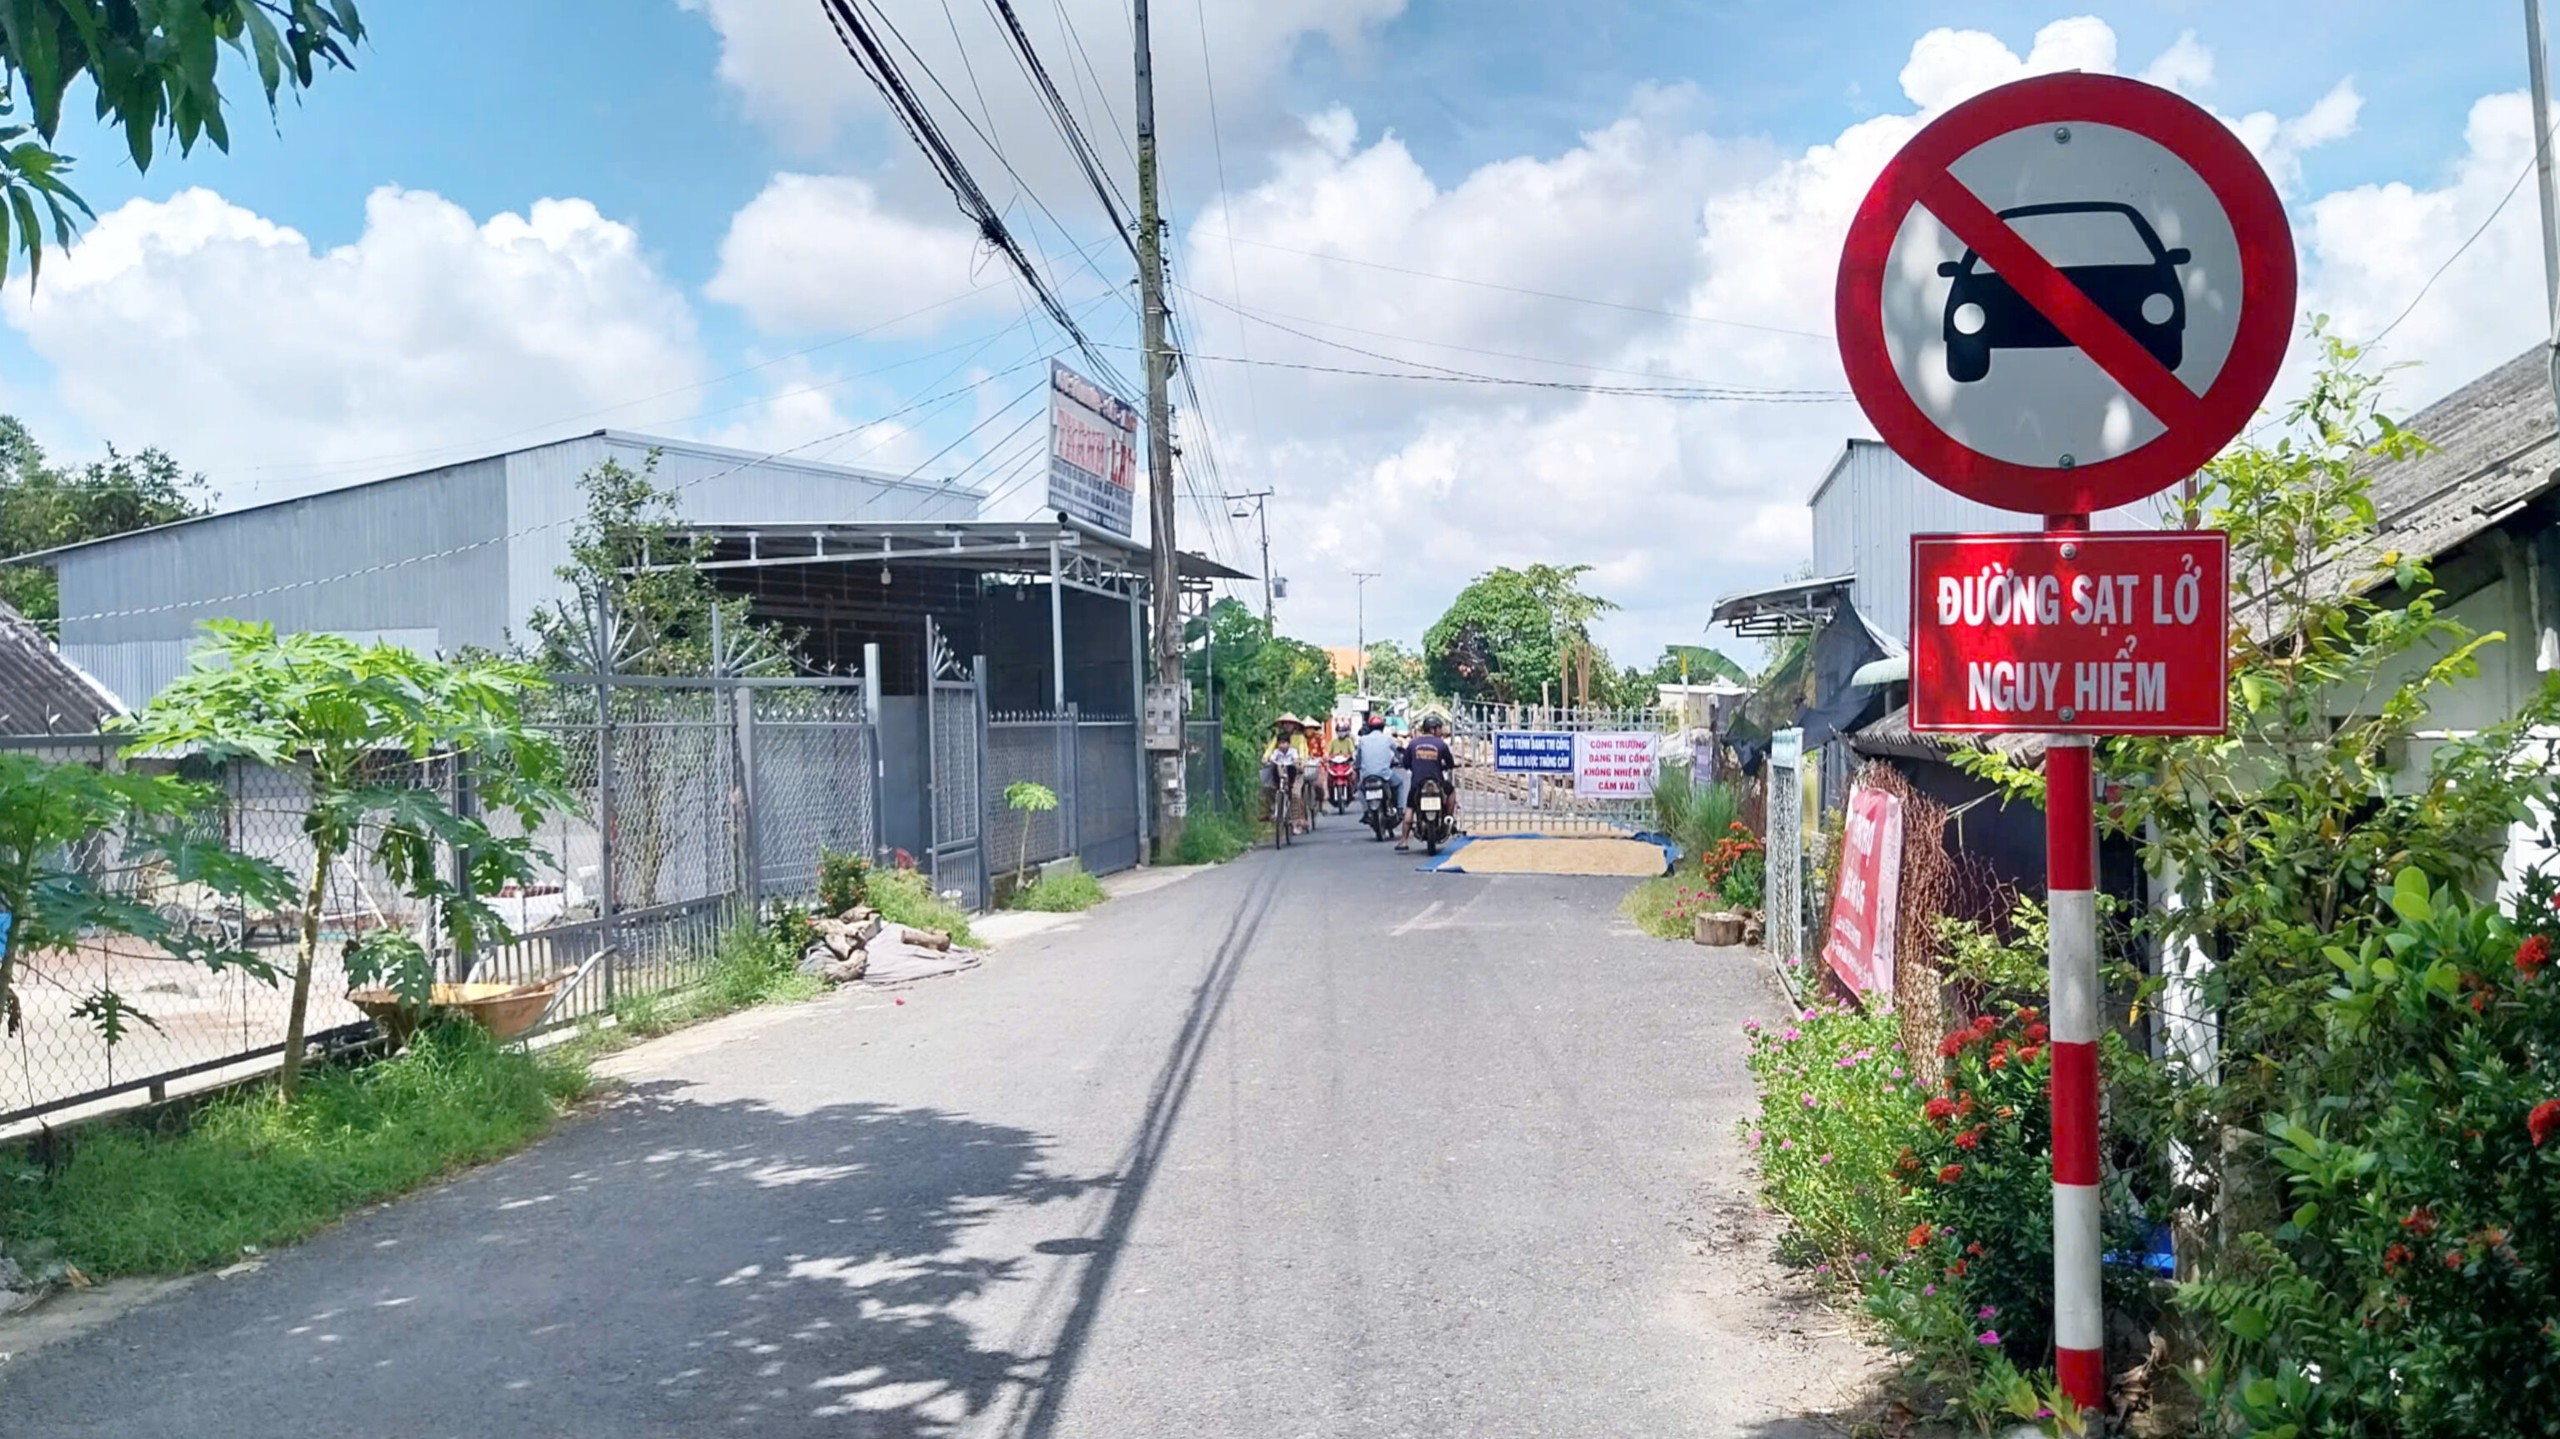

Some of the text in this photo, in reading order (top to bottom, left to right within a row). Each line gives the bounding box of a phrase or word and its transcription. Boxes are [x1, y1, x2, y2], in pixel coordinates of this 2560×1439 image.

[1937, 553, 2202, 636] ĐƯỜNG SẠT LỞ
[1967, 634, 2166, 712] NGUY HIỂM
[1590, 738, 1648, 750] CÔNG TRƯỜNG
[1614, 753, 1627, 764] THI
[1629, 752, 1651, 764] CÔNG
[1584, 766, 1612, 777] KHÔNG
